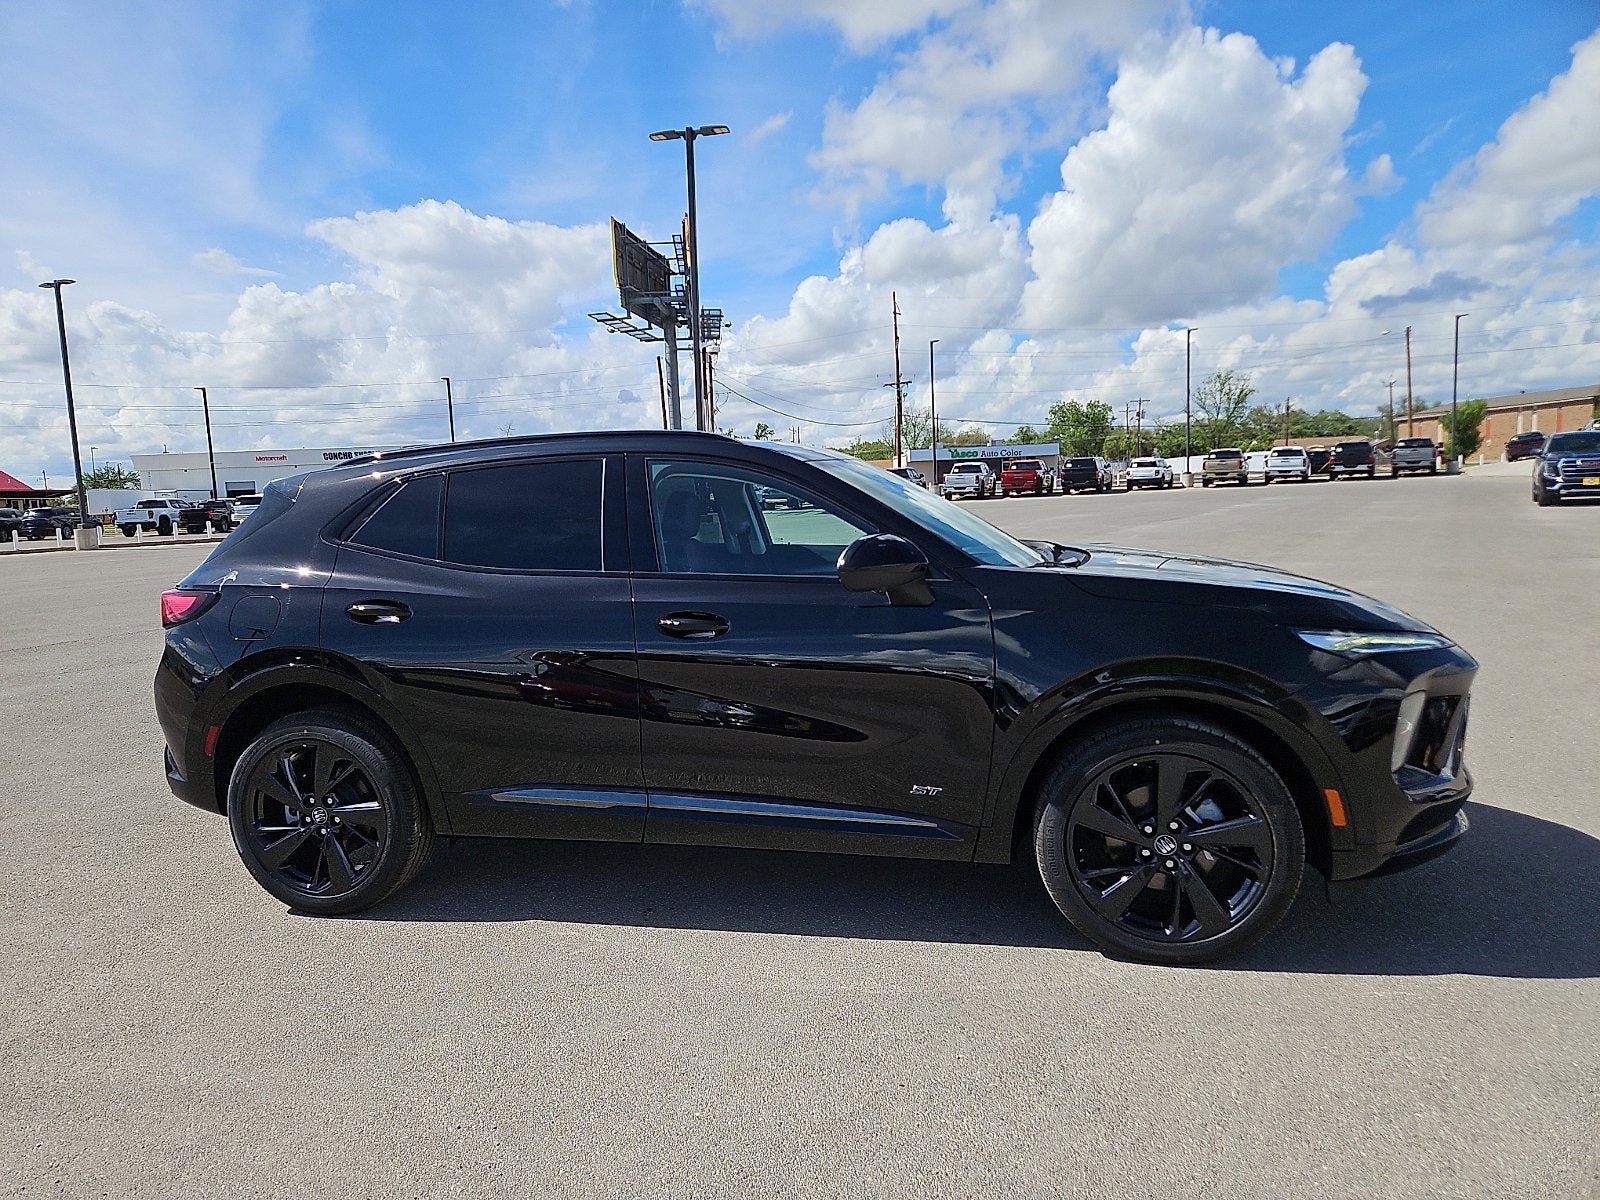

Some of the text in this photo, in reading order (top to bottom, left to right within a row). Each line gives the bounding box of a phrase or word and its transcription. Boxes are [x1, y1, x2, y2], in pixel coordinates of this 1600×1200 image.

[323, 452, 353, 460] CONCHO
[1000, 449, 1023, 457] Color
[910, 784, 943, 796] ST
